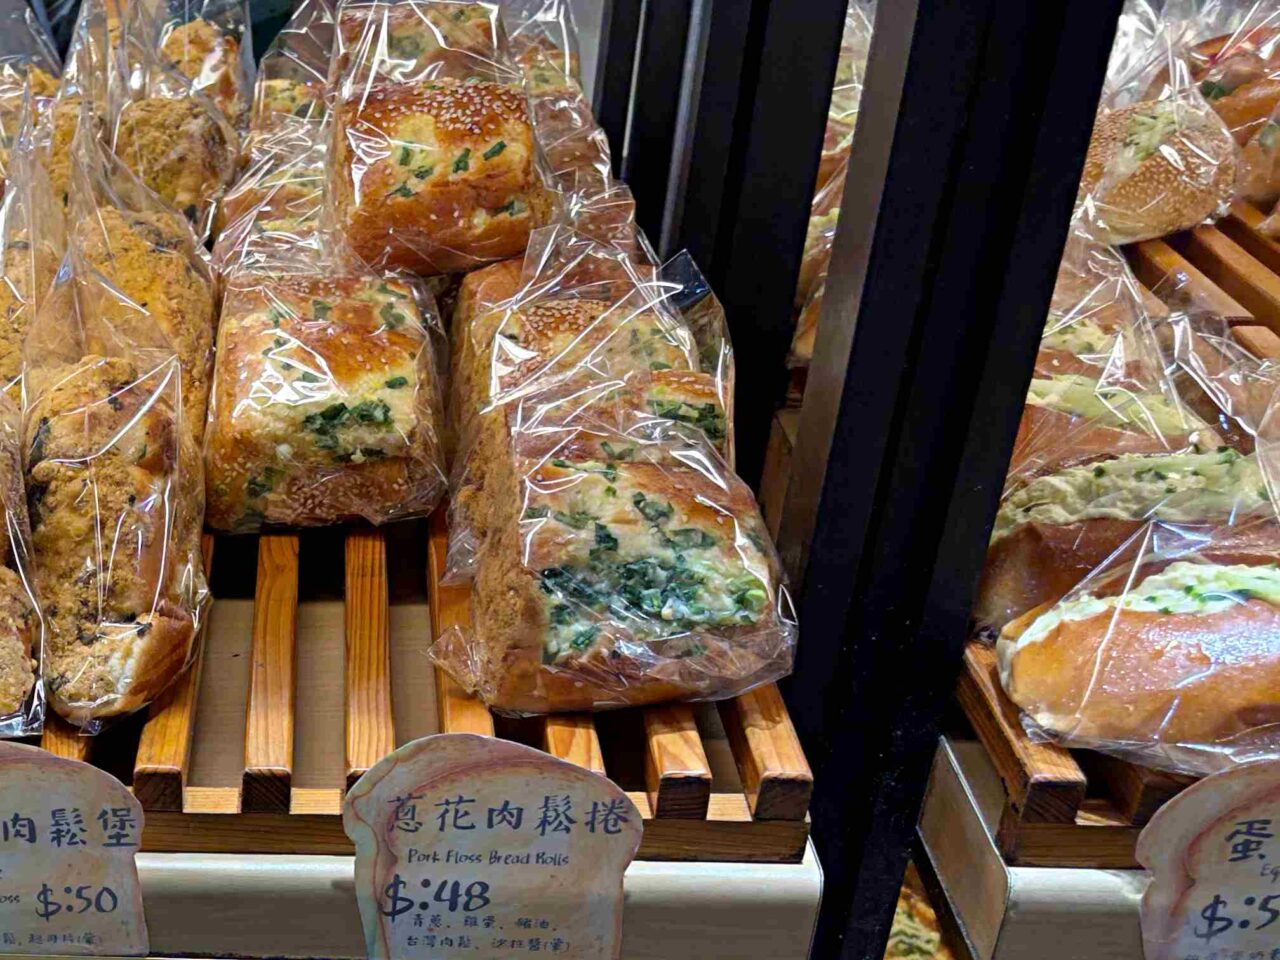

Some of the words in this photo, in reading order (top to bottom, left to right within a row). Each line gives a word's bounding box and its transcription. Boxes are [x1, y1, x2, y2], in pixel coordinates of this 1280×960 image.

[407, 848, 440, 863] Pork
[446, 849, 482, 864] Floss
[489, 850, 530, 865] Bread
[535, 851, 569, 866] Rolls
